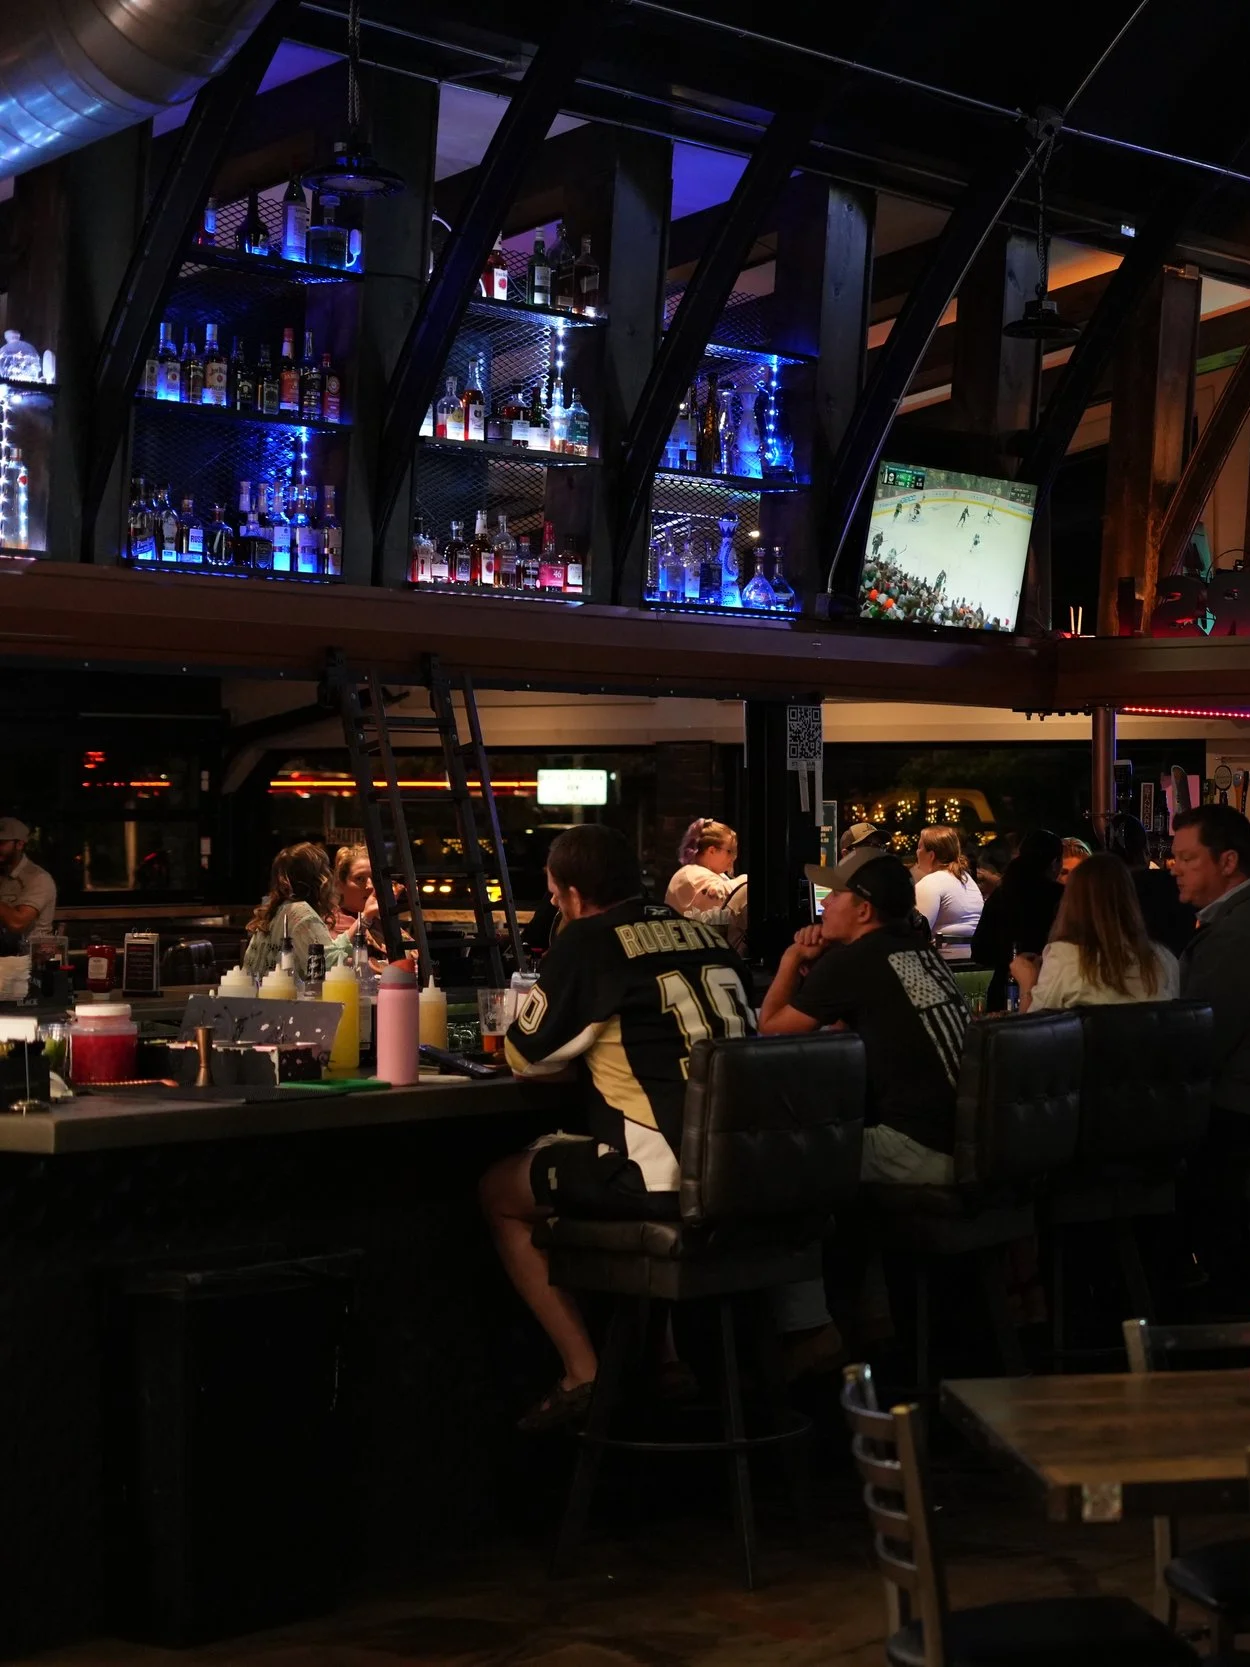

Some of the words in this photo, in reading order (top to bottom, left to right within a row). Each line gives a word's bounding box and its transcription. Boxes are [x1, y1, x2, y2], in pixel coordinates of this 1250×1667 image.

[553, 570, 566, 578] 46
[614, 919, 730, 959] ROBERTS
[517, 984, 549, 1036] 0
[655, 964, 757, 1081] 10
